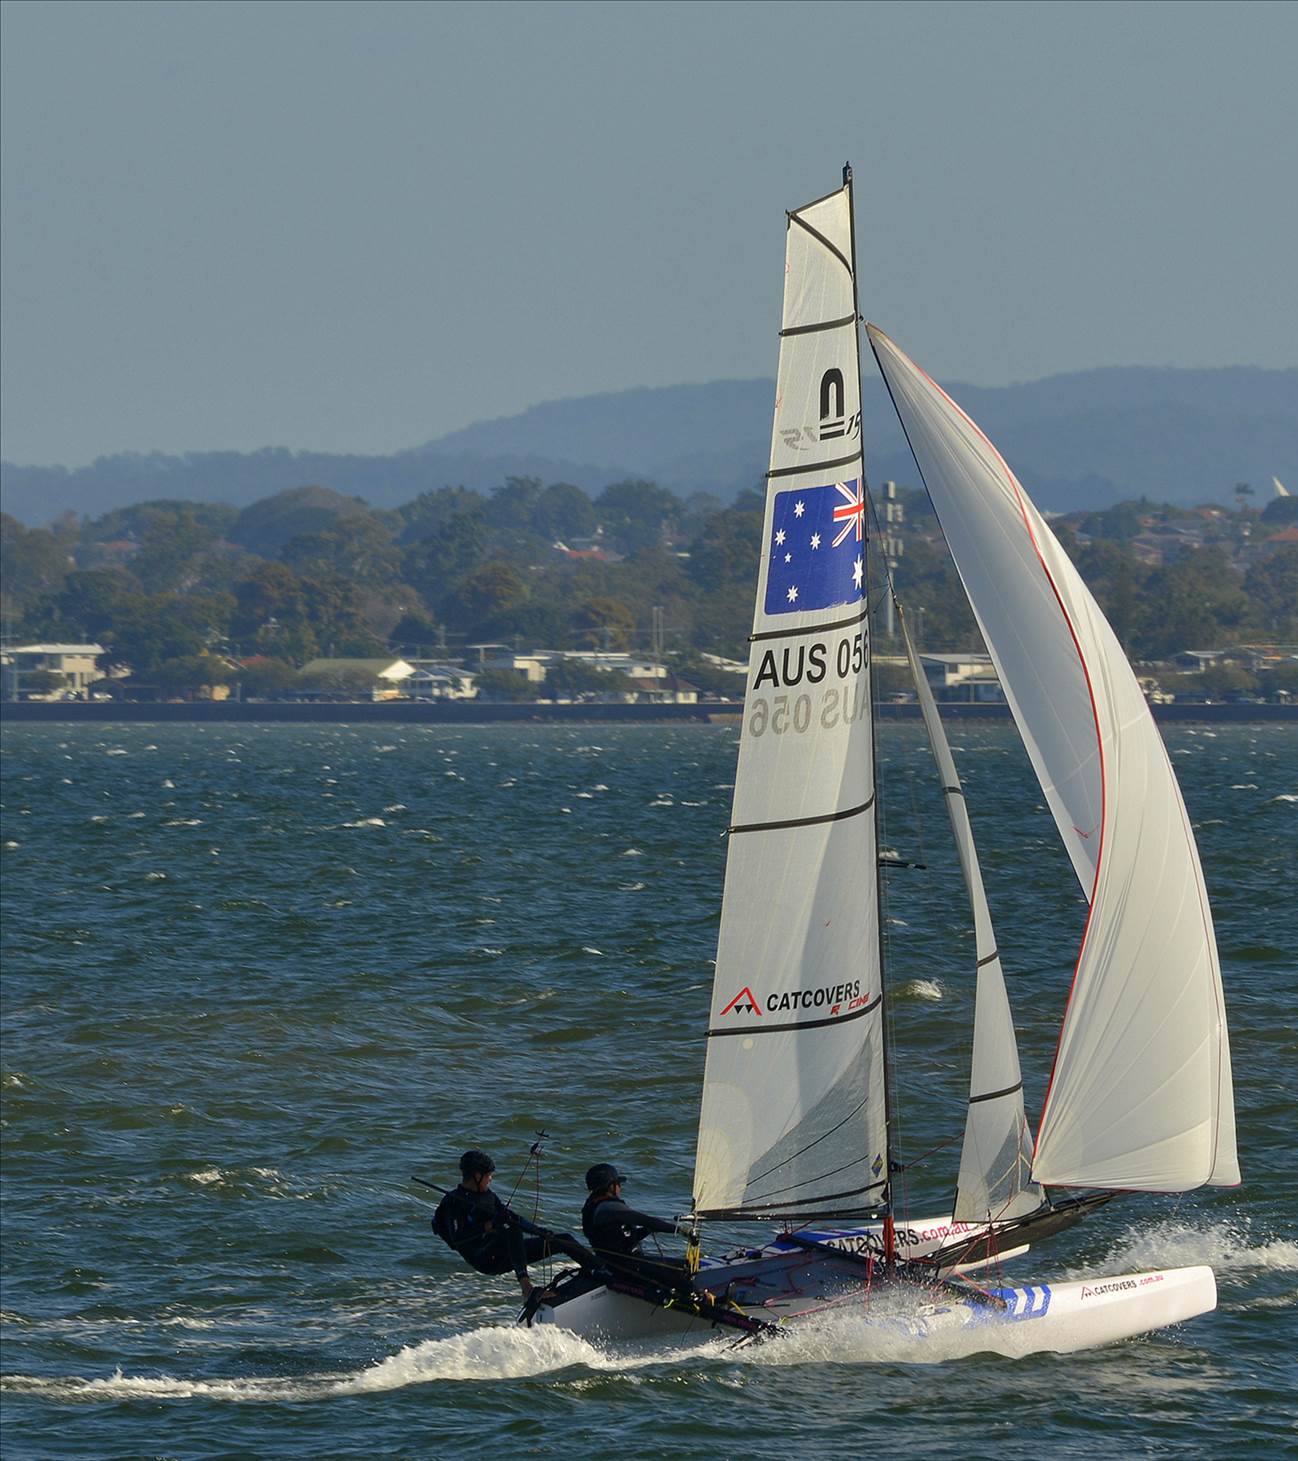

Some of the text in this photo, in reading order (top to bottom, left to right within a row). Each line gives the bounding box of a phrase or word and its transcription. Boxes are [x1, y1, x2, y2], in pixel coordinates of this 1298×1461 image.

[753, 629, 869, 690] AUS 056
[766, 979, 860, 1012] CATCOVERS
